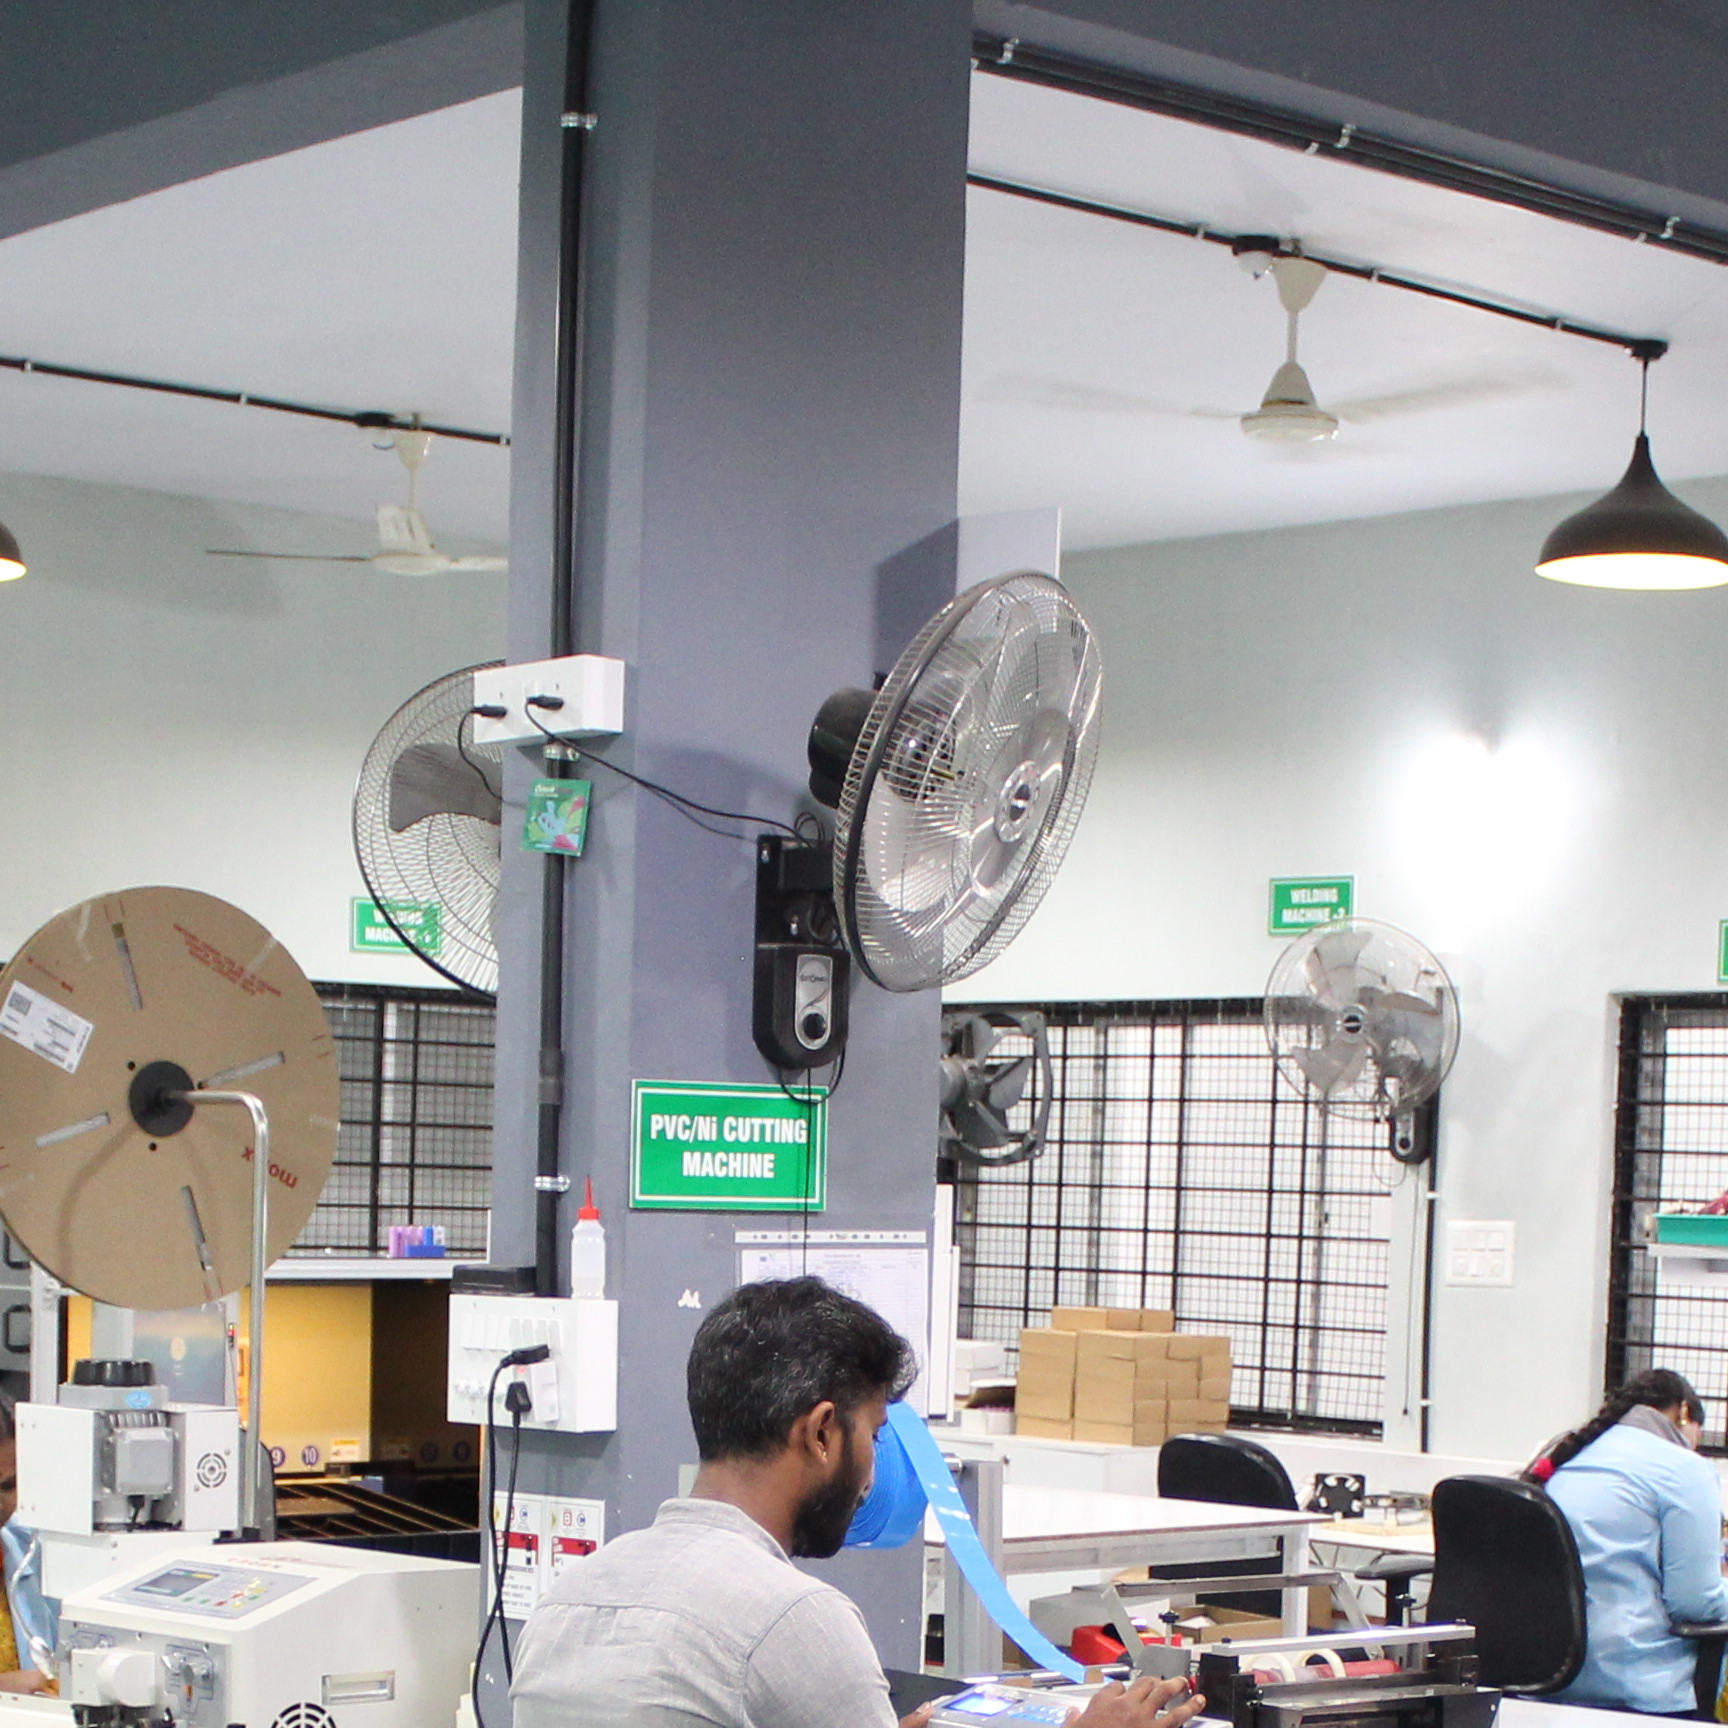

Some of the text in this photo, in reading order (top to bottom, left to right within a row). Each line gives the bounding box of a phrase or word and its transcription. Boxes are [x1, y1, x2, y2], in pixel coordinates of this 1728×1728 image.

[1290, 887, 1339, 904] WELDING
[1281, 906, 1330, 924] MACHINE
[650, 1113, 809, 1144] PVC/Ni CUTTING
[240, 1144, 298, 1189] mox
[682, 1150, 776, 1179] MACHINE
[304, 1447, 317, 1464] 10
